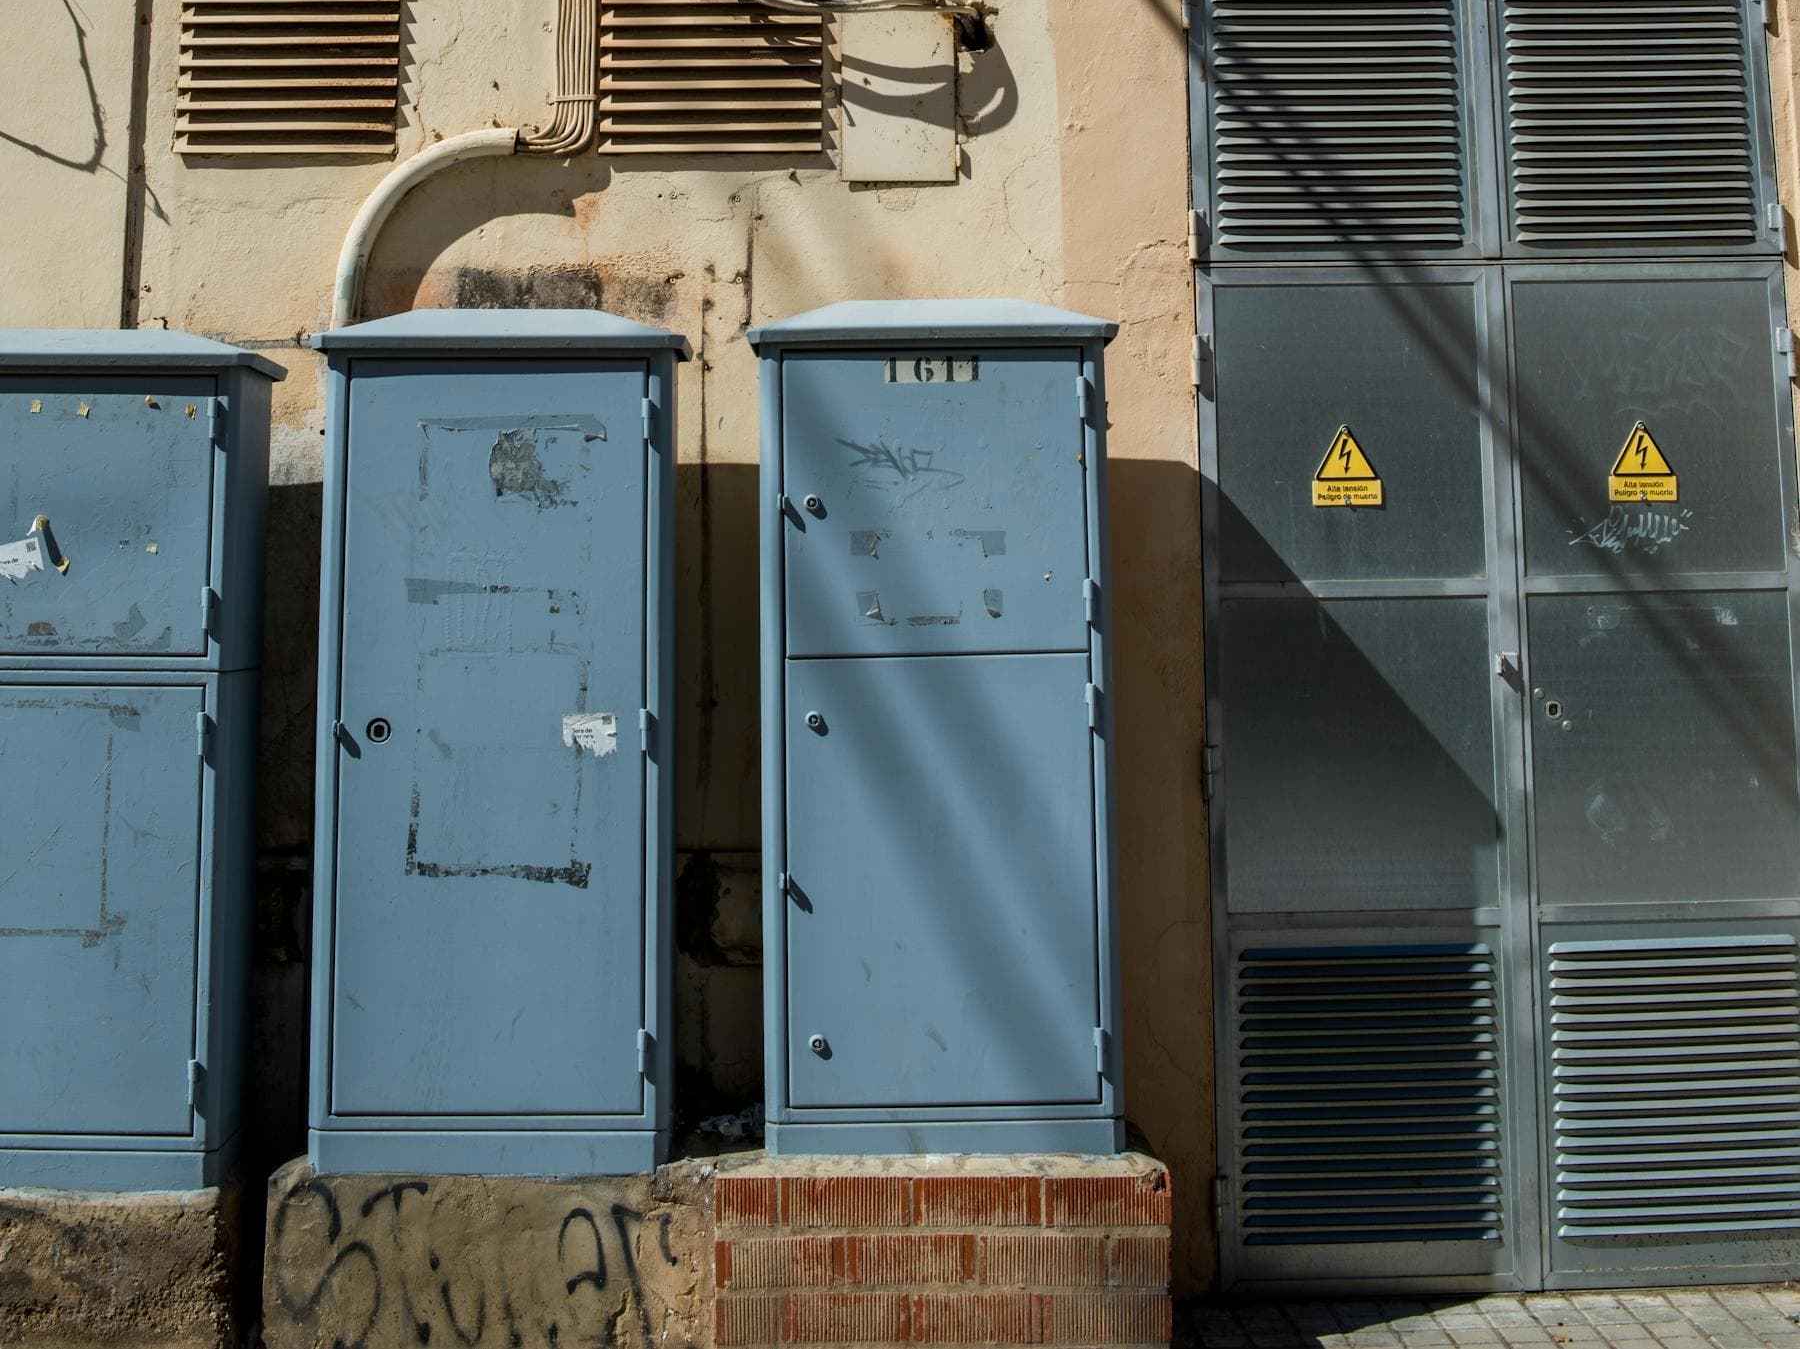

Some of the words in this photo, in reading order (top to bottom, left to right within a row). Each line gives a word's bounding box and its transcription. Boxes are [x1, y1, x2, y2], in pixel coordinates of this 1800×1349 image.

[885, 356, 980, 382] 1611
[1343, 484, 1368, 492] tensión
[1639, 480, 1664, 488] tensión
[1317, 493, 1342, 501] Peligro
[1614, 489, 1638, 497] Peligro
